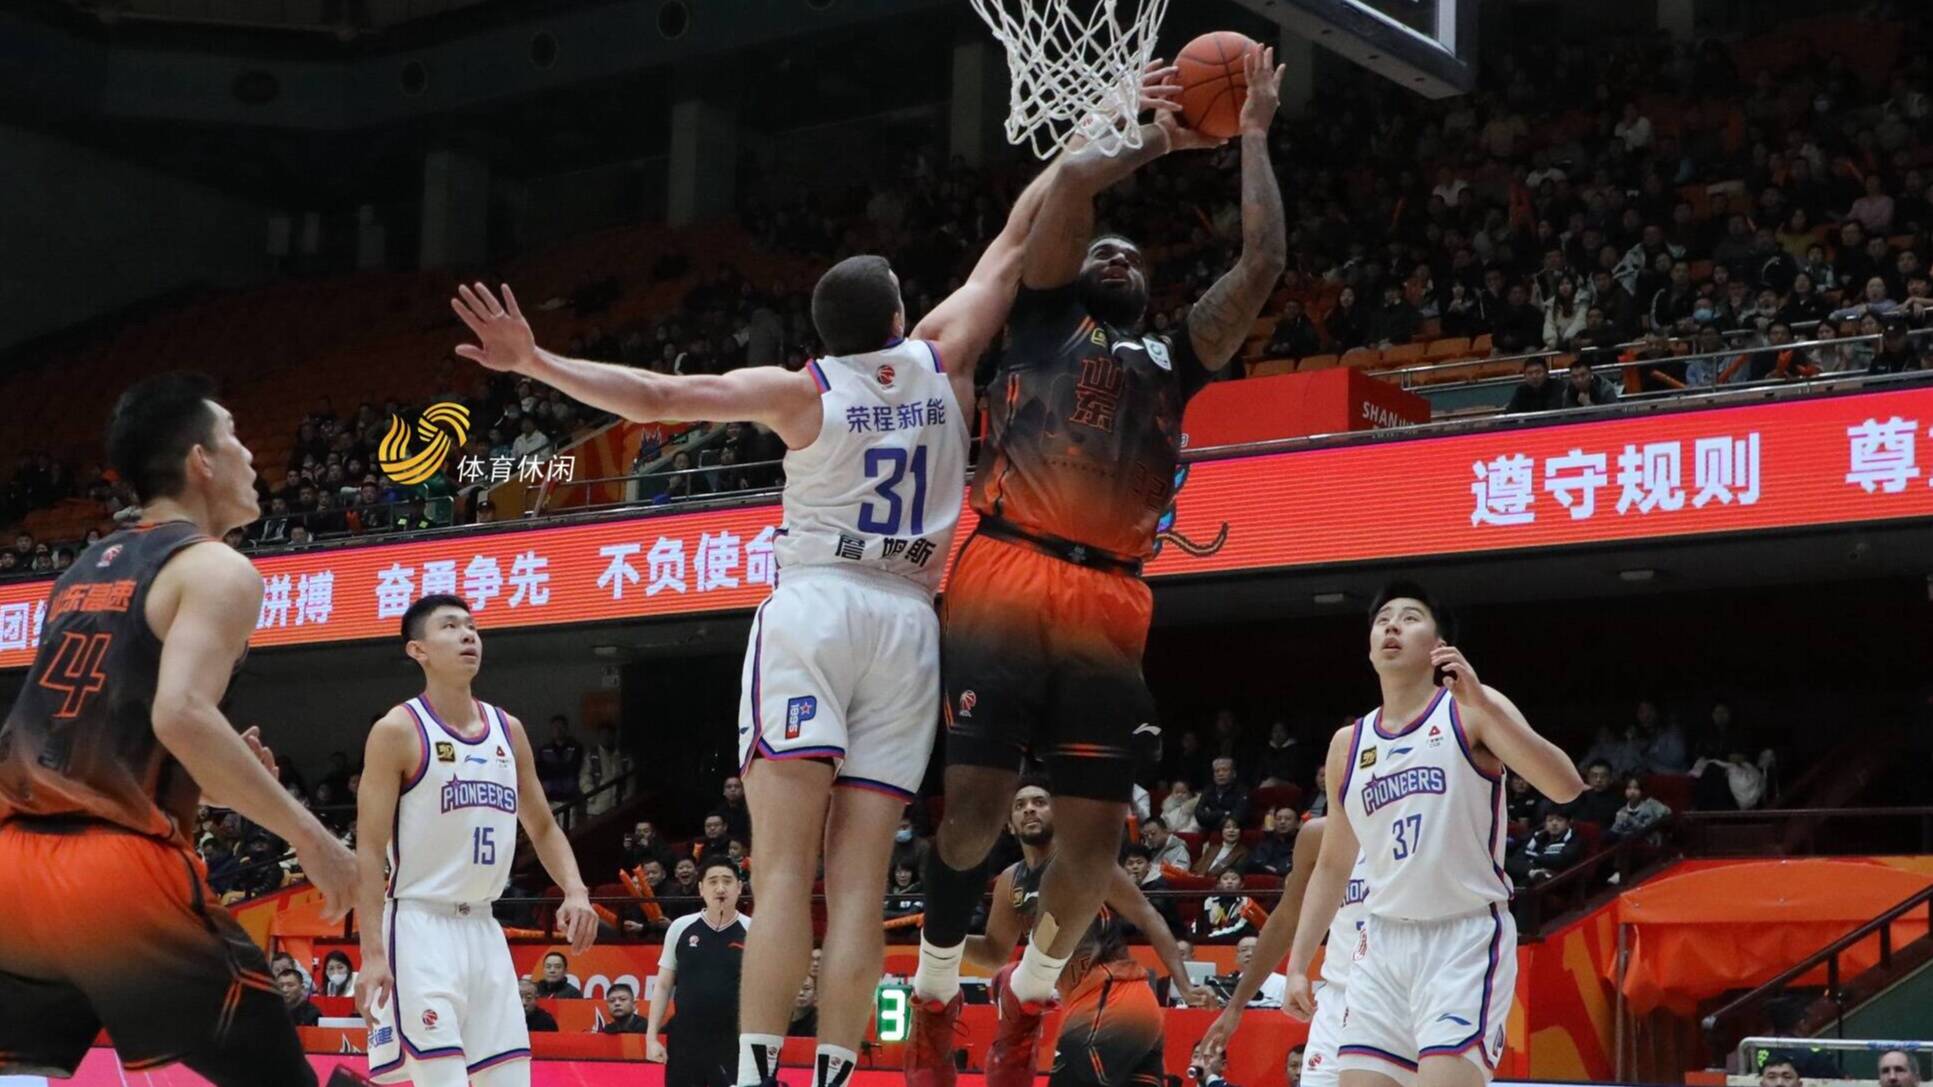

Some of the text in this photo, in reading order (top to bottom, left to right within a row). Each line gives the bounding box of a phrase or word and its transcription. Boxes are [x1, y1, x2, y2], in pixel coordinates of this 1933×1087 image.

[847, 398, 946, 433] 荣程新能
[1470, 432, 1762, 527] 遵守规则
[1845, 416, 1933, 494] 尊
[858, 446, 928, 535] 31
[376, 550, 550, 619] 奋勇争先
[597, 526, 777, 599] 不负使命
[39, 632, 113, 717] 4
[441, 777, 517, 814] PIONEERS
[1361, 766, 1447, 816] PIONEERS
[473, 827, 495, 865] 15
[1392, 814, 1422, 860] 37
[881, 989, 906, 1041] 3
